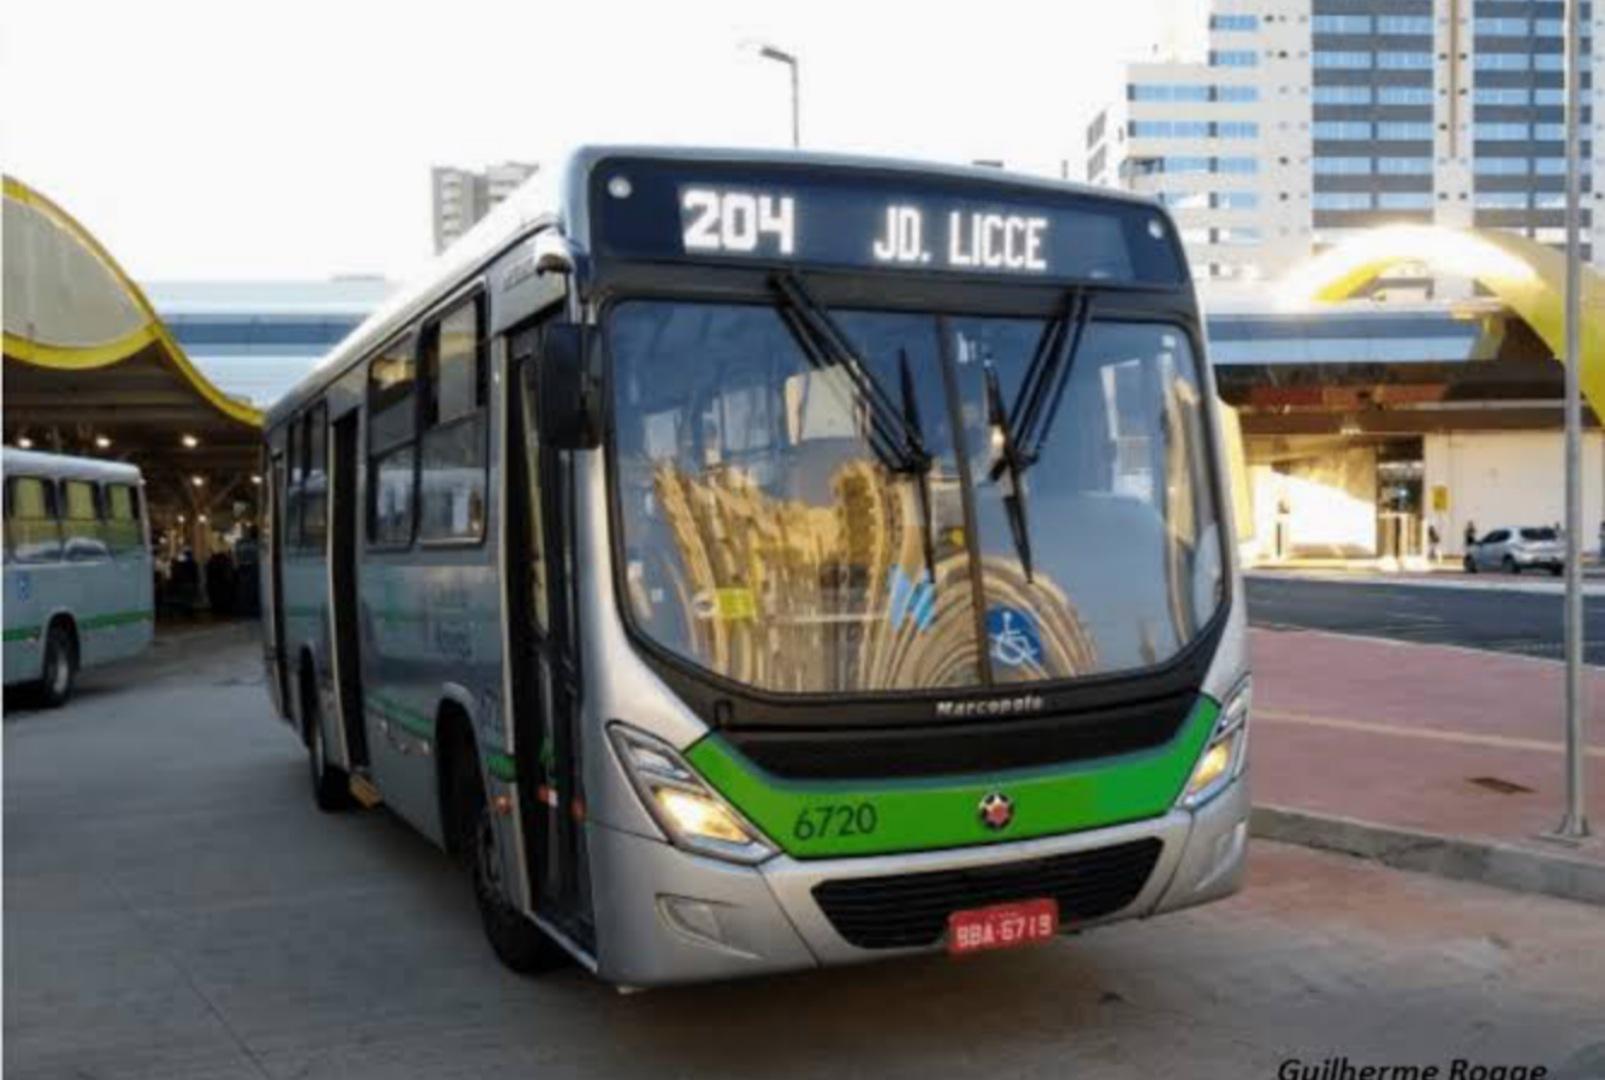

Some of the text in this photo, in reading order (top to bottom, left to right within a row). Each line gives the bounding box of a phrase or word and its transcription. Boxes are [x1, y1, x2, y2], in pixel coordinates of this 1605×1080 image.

[681, 188, 1048, 271] 204 JD. LICCE
[793, 802, 878, 841] 6720
